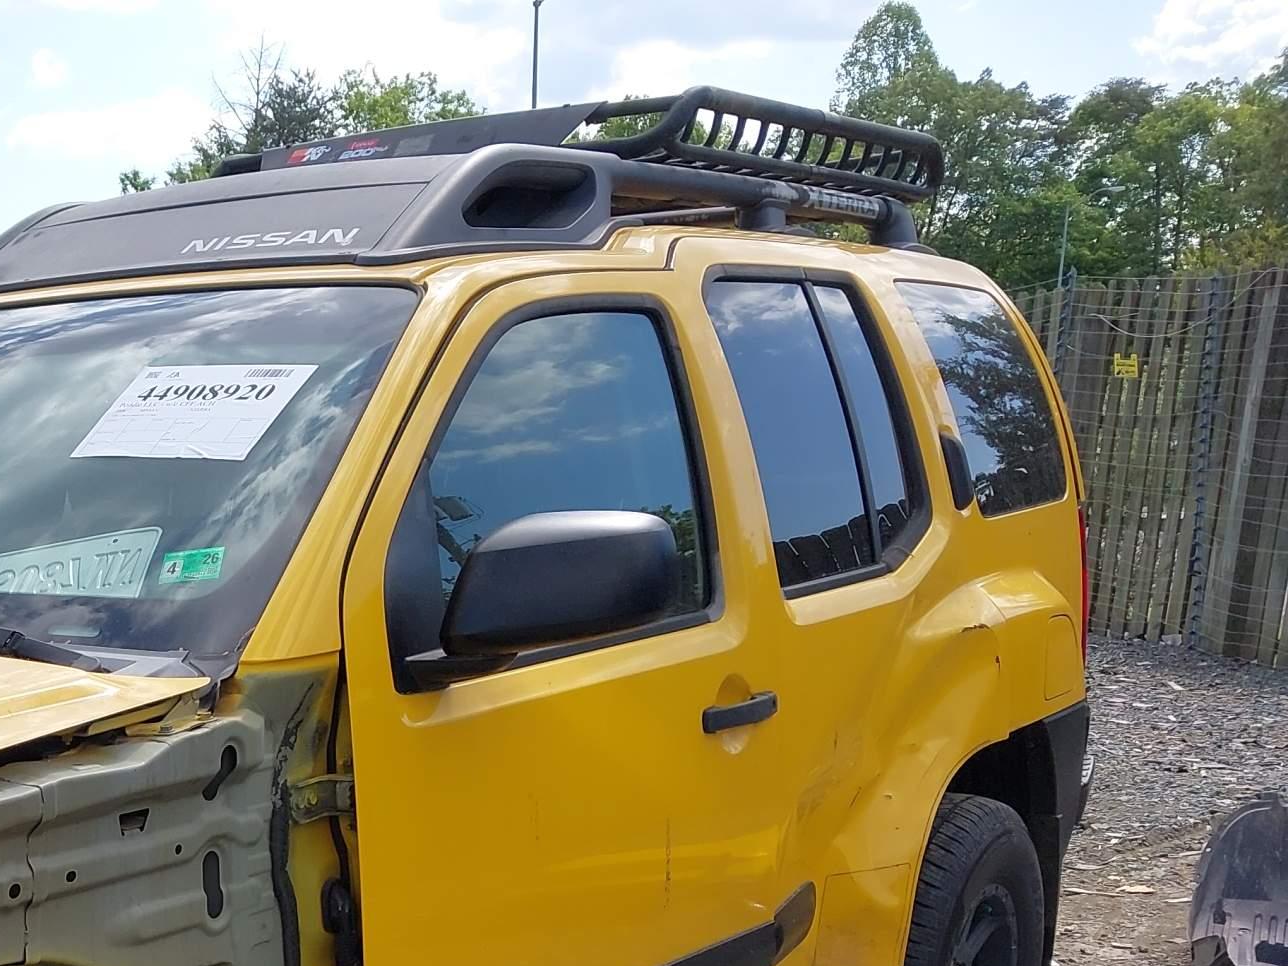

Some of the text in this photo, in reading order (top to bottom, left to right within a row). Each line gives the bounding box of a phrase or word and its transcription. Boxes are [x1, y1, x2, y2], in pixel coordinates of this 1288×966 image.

[181, 228, 360, 254] NISSAN
[137, 383, 276, 401] 44908920
[203, 552, 219, 565] 26
[167, 561, 177, 575] 4
